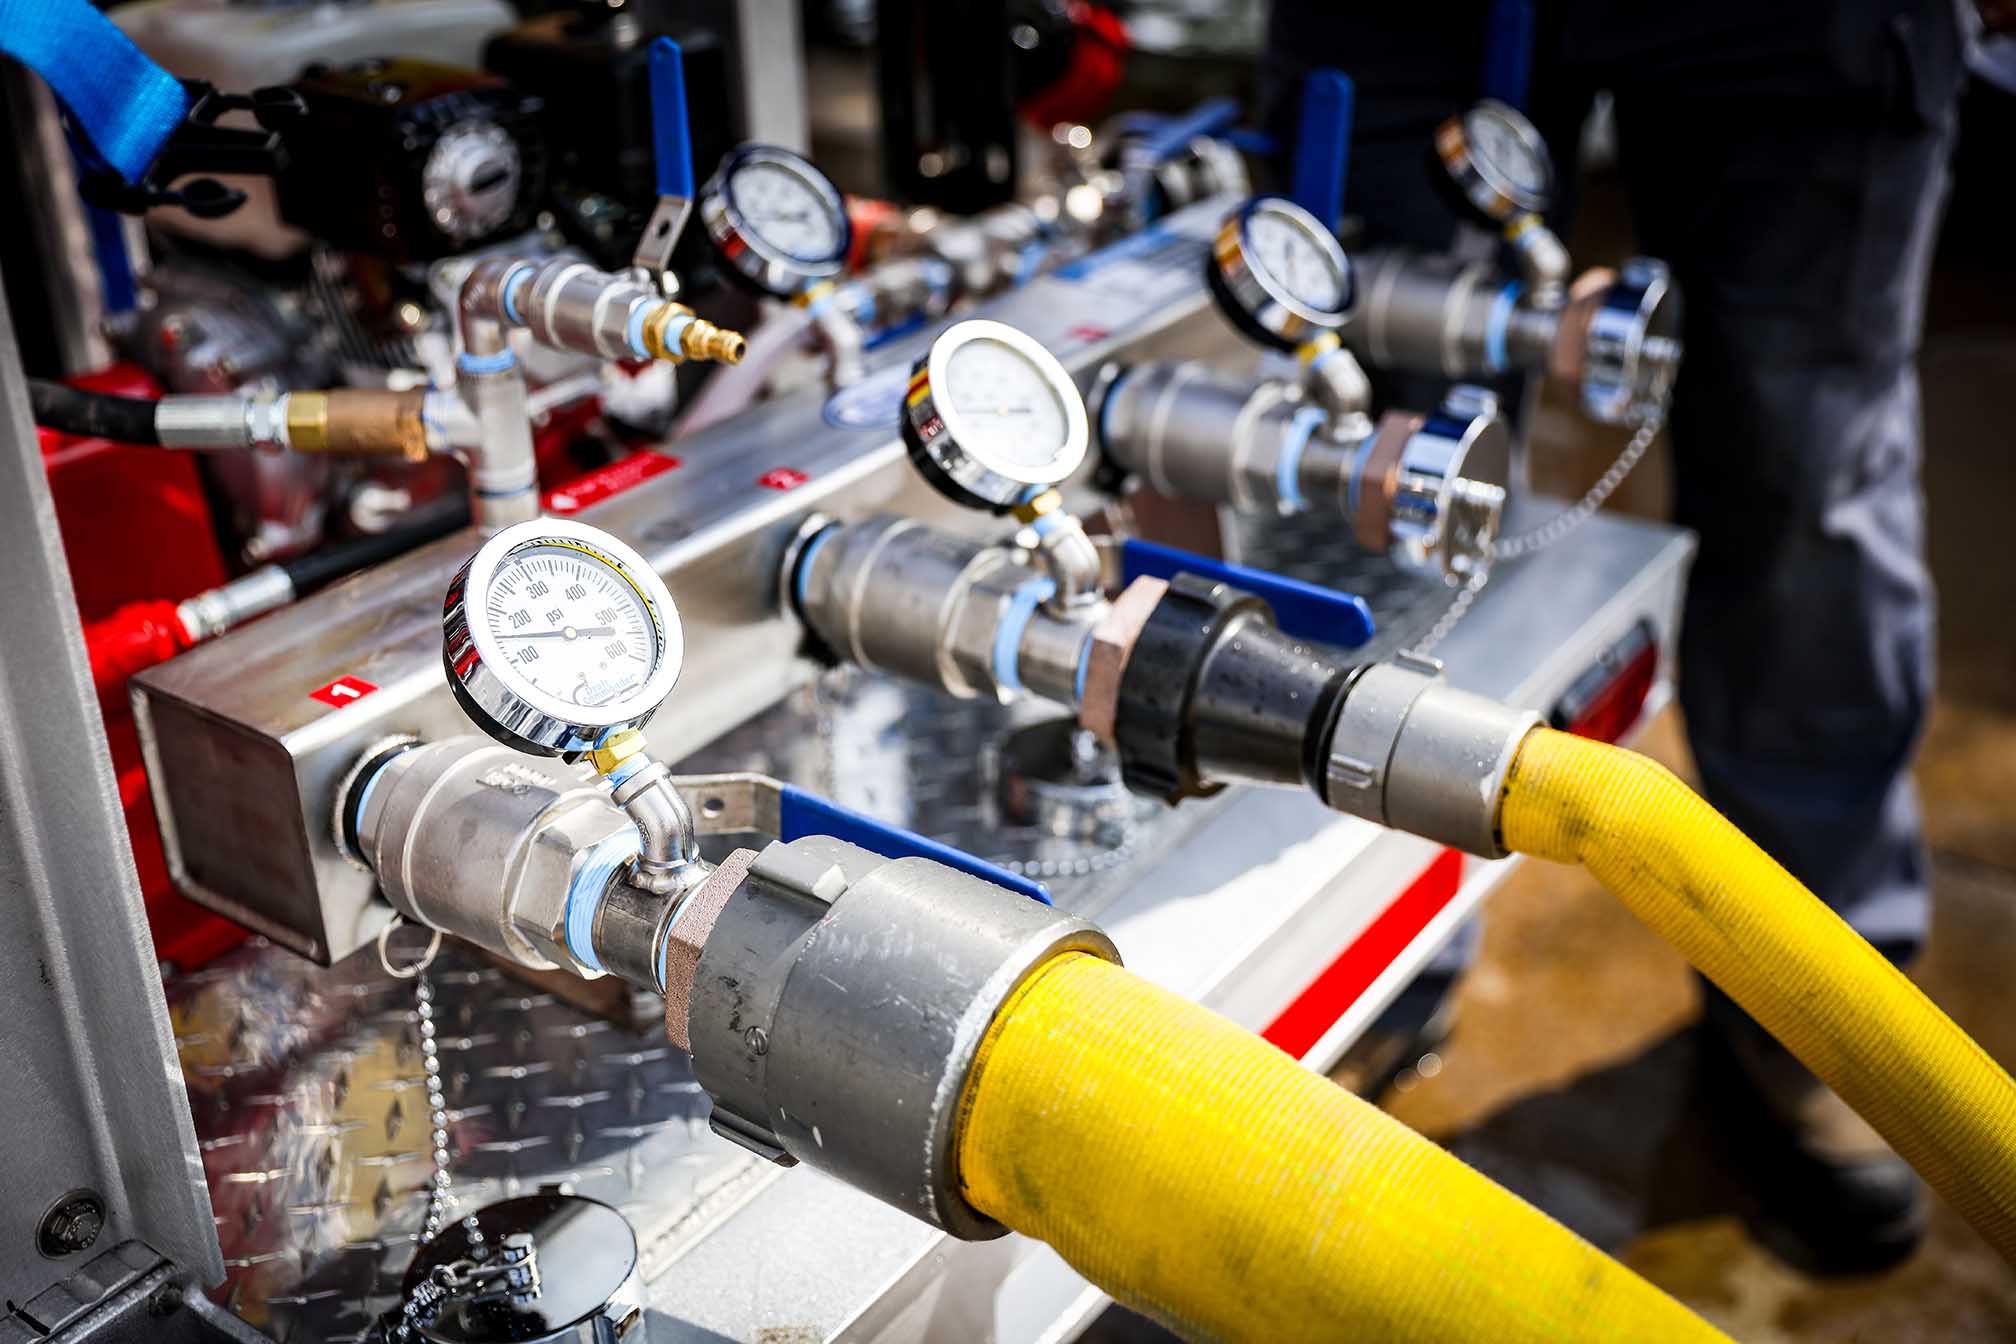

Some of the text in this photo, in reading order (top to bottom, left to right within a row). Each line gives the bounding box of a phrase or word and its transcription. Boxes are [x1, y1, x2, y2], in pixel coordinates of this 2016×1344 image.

[526, 580, 549, 600] 300
[565, 583, 587, 602] 400
[508, 609, 532, 629] 200
[545, 608, 565, 626] psi
[594, 607, 618, 626] 500
[517, 645, 539, 664] 100
[604, 640, 628, 660] 600
[331, 684, 360, 698] 1
